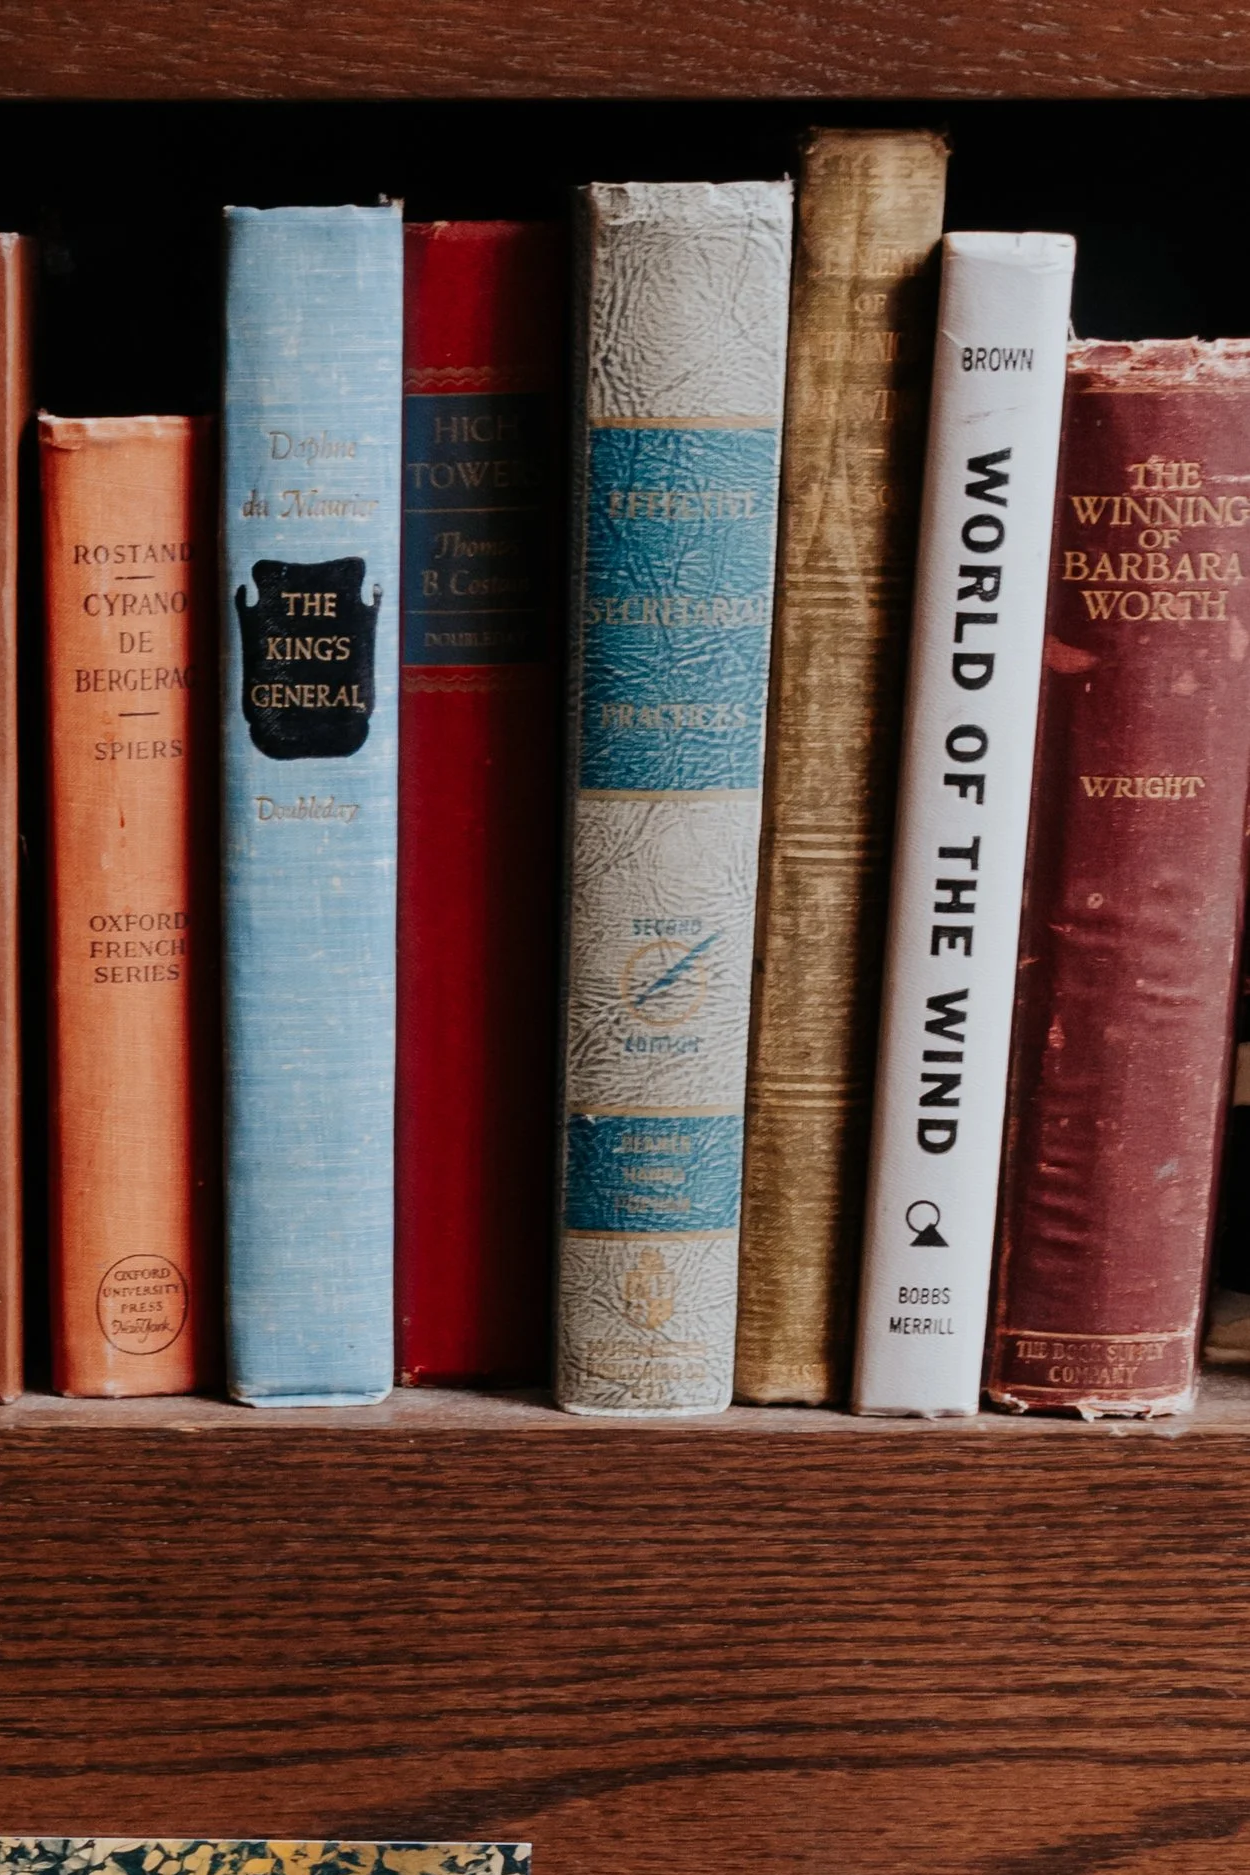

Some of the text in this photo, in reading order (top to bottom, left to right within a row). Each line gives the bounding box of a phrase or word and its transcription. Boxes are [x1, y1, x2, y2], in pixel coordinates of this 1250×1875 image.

[961, 346, 1034, 372] BROWN
[270, 430, 356, 465] Daphne
[1130, 461, 1201, 490] THE
[242, 488, 379, 518] du Maurier
[1072, 496, 1249, 526] WINNING
[1138, 529, 1181, 549] OF
[74, 542, 194, 565] ROSTAND
[1062, 552, 1246, 583] BARBARA
[83, 592, 188, 616] CYRANO
[281, 592, 337, 618] THE
[1081, 590, 1230, 621] WORTH
[120, 631, 153, 654] DE
[267, 635, 350, 660] KING'S
[76, 666, 196, 693] BERGERAC
[251, 684, 366, 710] GENERAL
[95, 740, 182, 761] SPIERS
[1080, 776, 1204, 800] WRIGHT
[255, 796, 359, 824] Doubleday
[917, 446, 1013, 1156] WORLD OF THE WIND
[89, 911, 188, 932] OXFORD
[90, 939, 186, 960] FRENCH
[95, 964, 180, 985] SERIES
[114, 1268, 171, 1281] OXFORD
[103, 1284, 180, 1298] UNIVERSITY
[898, 1287, 951, 1305] BOBBS
[121, 1302, 163, 1314] PRESS
[889, 1317, 954, 1336] MERRILL
[1016, 1340, 1049, 1360] THE
[1107, 1341, 1166, 1361] SUPPLY
[1049, 1366, 1138, 1385] COMPANY
